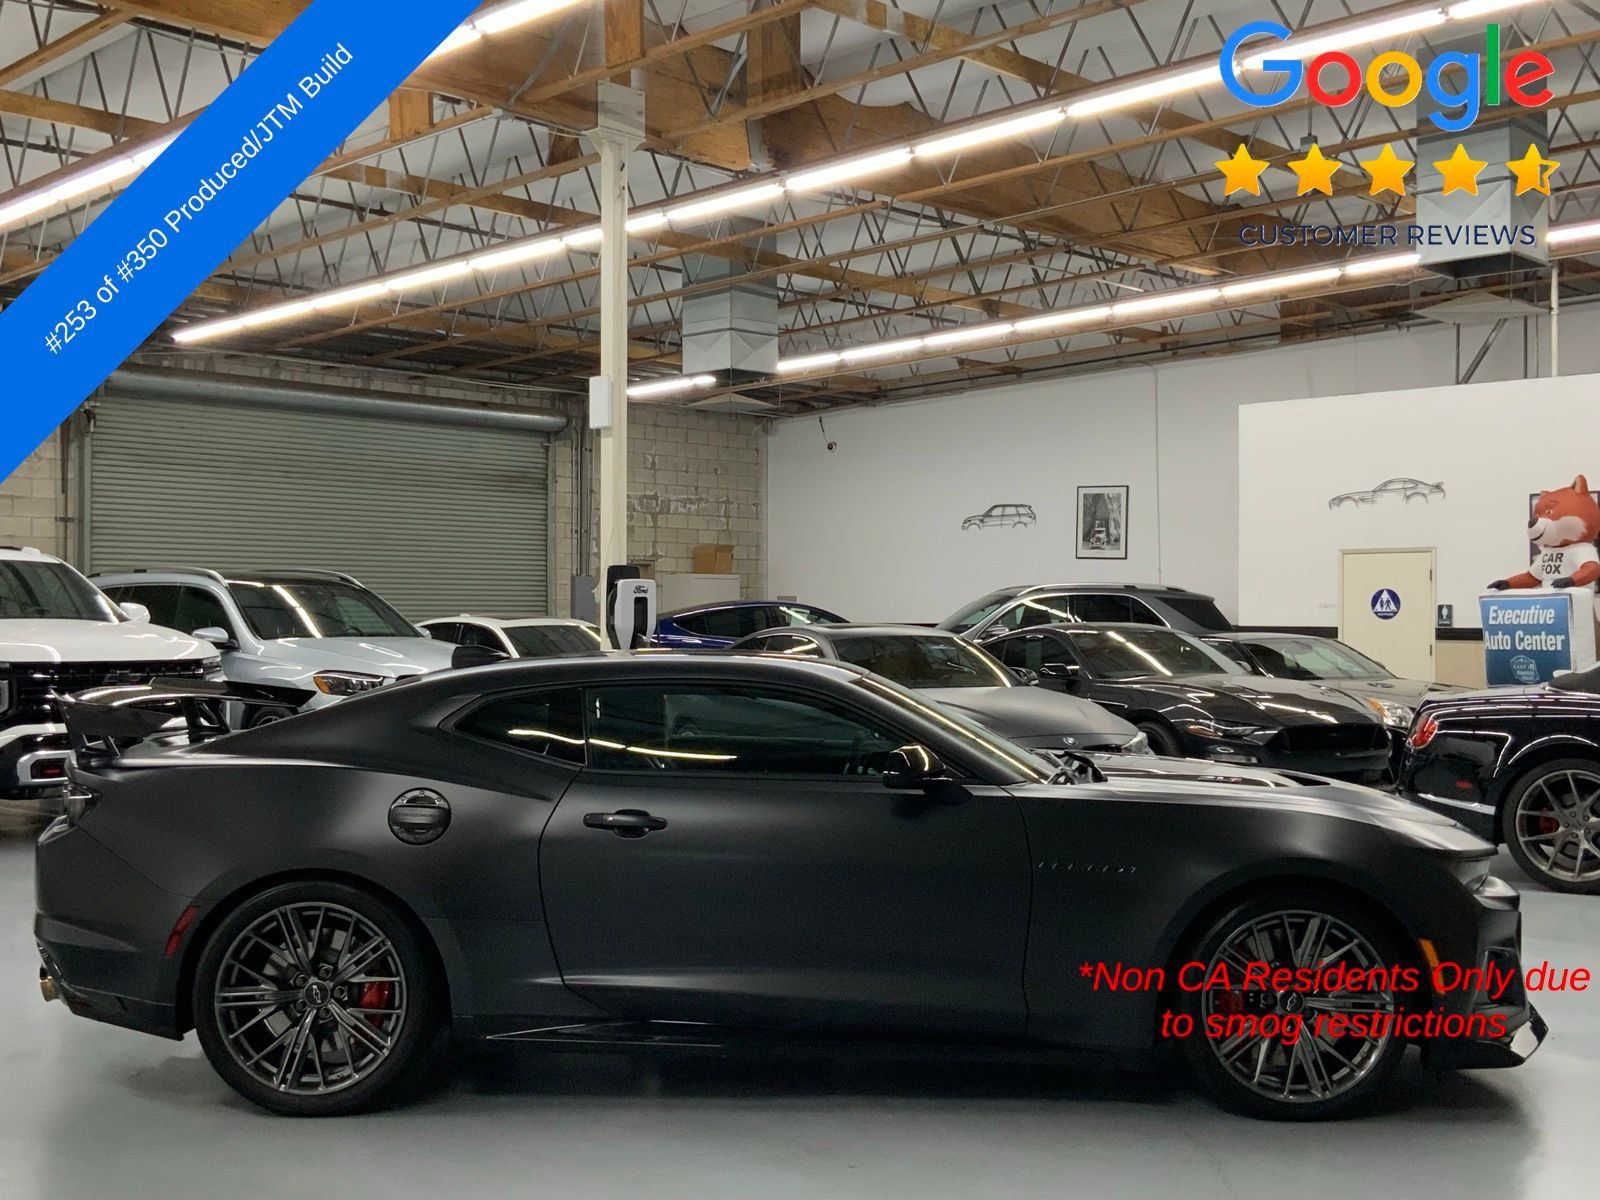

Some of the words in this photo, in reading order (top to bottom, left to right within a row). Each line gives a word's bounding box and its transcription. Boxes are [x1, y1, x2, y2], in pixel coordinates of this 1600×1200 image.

[1541, 552, 1564, 563] CAR
[1541, 563, 1562, 575] FOX
[1488, 604, 1555, 625] Executive
[1484, 630, 1511, 651] Auto
[1514, 630, 1565, 651] Center
